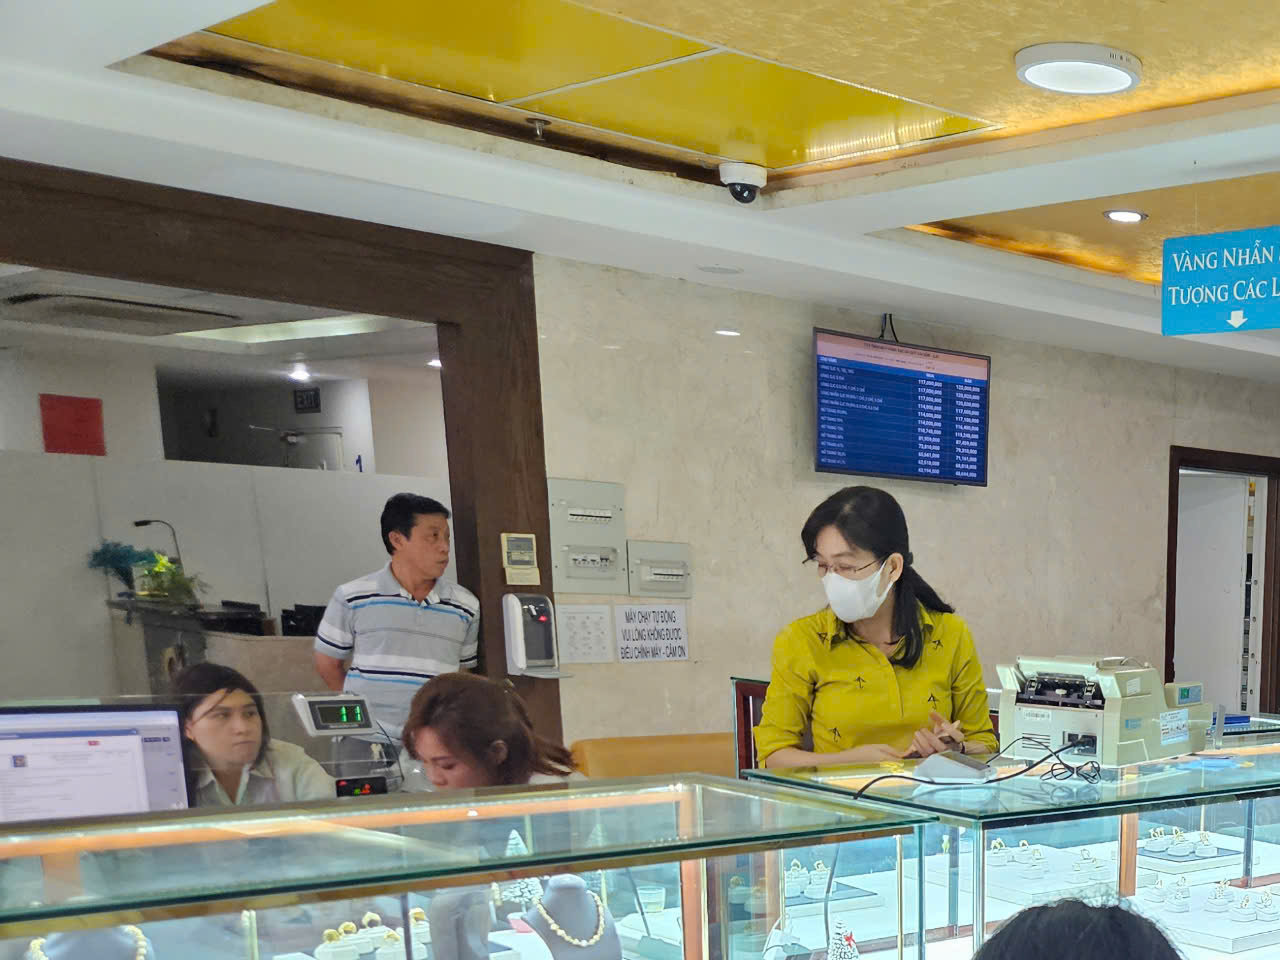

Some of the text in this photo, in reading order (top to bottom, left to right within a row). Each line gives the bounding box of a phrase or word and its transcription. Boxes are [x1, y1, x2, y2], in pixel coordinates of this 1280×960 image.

[1172, 250, 1218, 272] VÀNG
[1223, 240, 1274, 268] NHẪN
[1168, 284, 1229, 308] TƯỢNG
[1233, 277, 1268, 301] CÁC
[625, 608, 637, 623] MÁY
